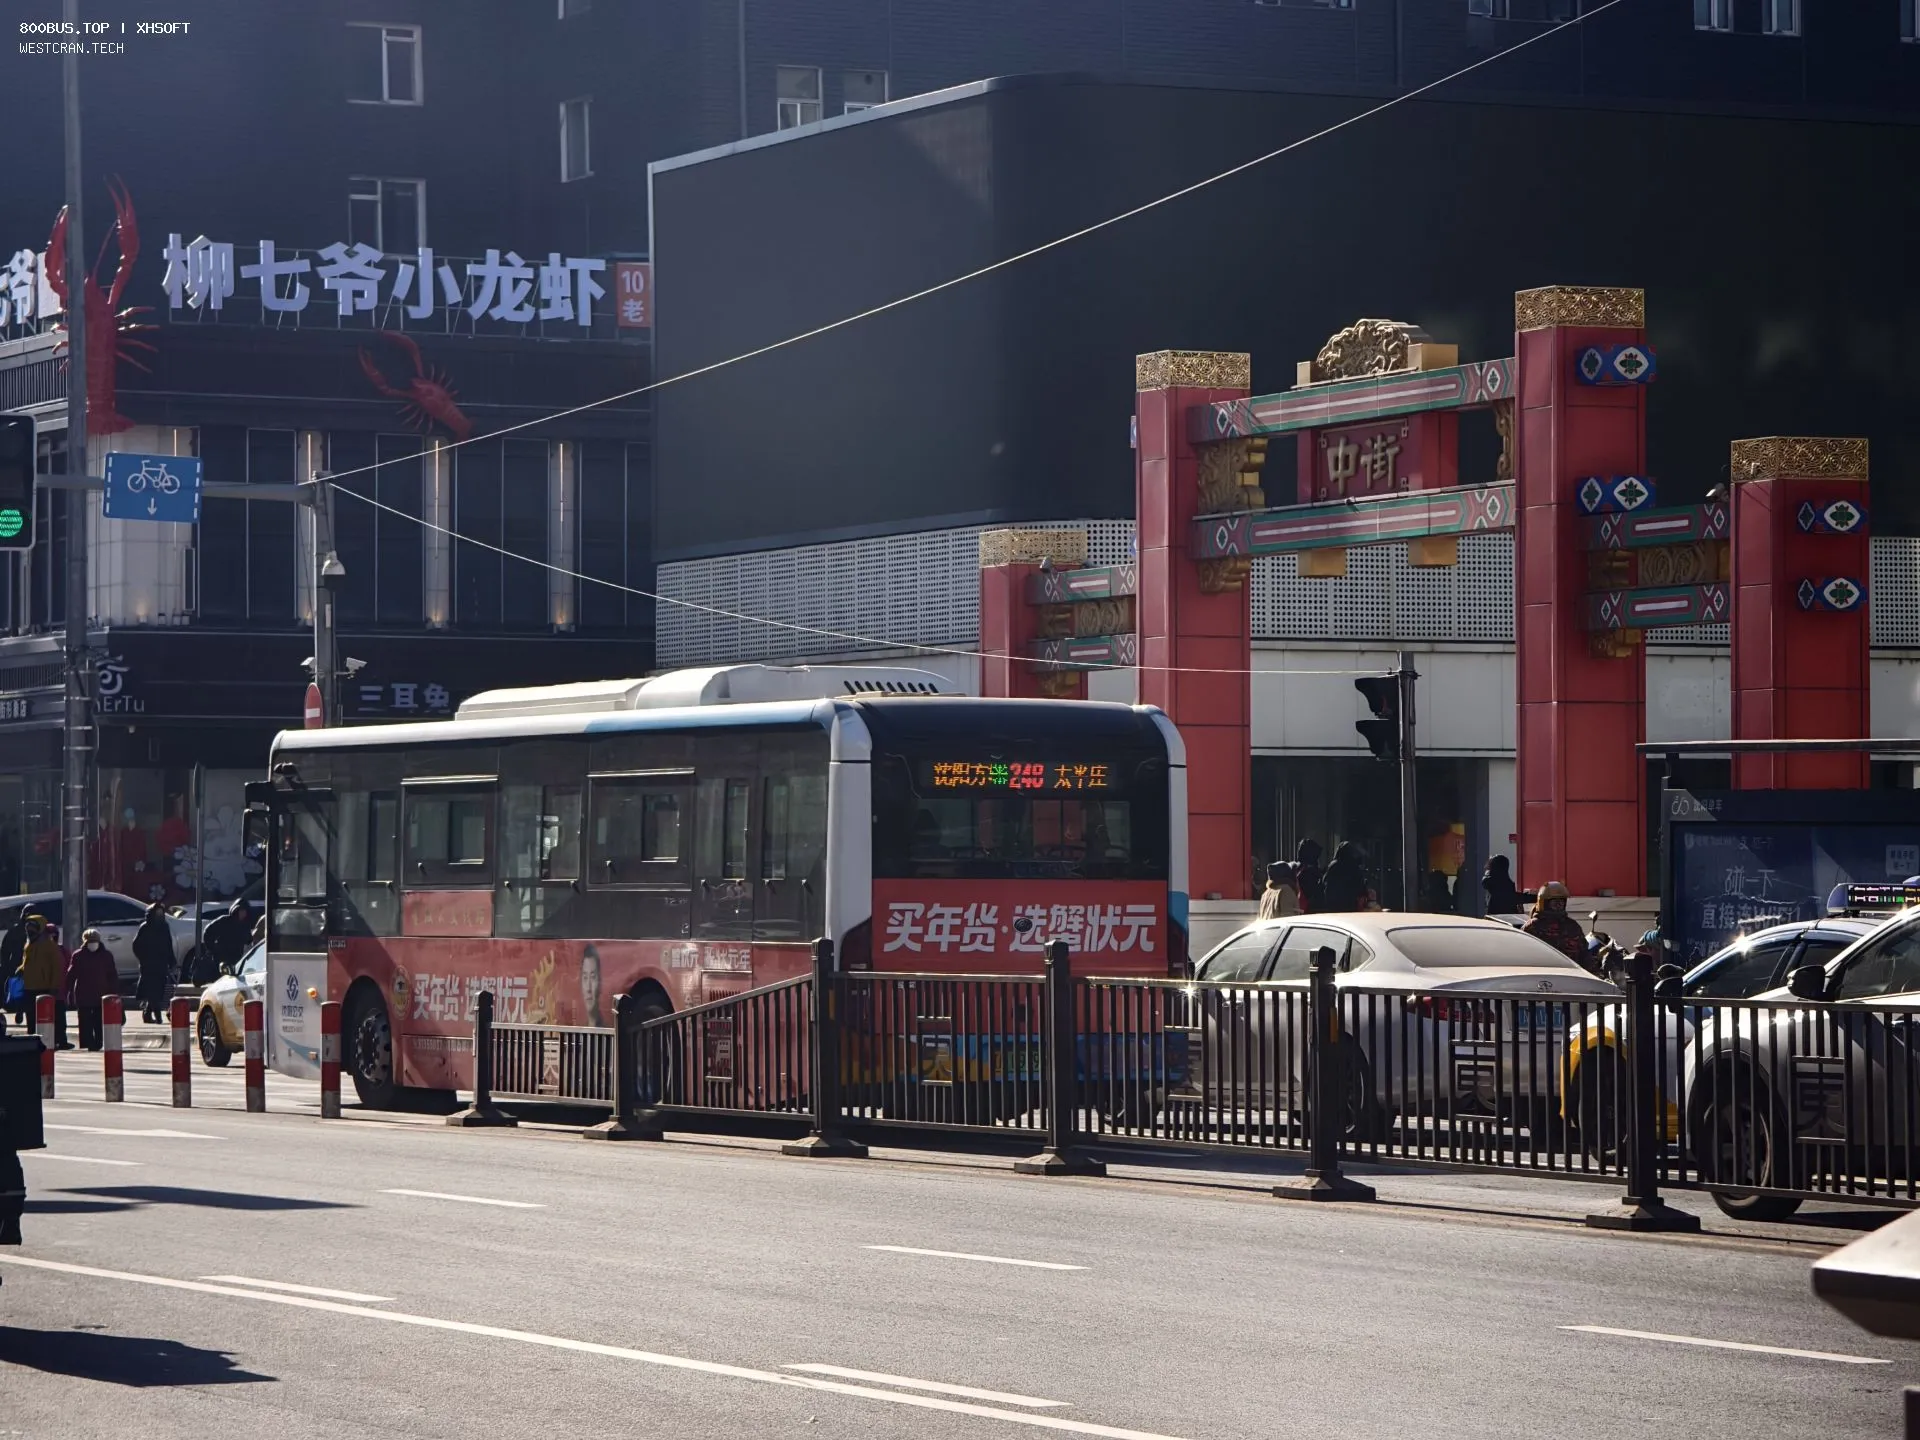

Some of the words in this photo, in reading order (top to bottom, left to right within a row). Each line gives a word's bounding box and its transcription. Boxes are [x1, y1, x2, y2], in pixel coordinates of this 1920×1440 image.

[163, 233, 606, 327] 柳七爷小龙虾
[621, 271, 644, 293] 10
[622, 298, 645, 323] 老
[1327, 434, 1400, 495] 中街
[1054, 764, 1109, 789] 太平庄
